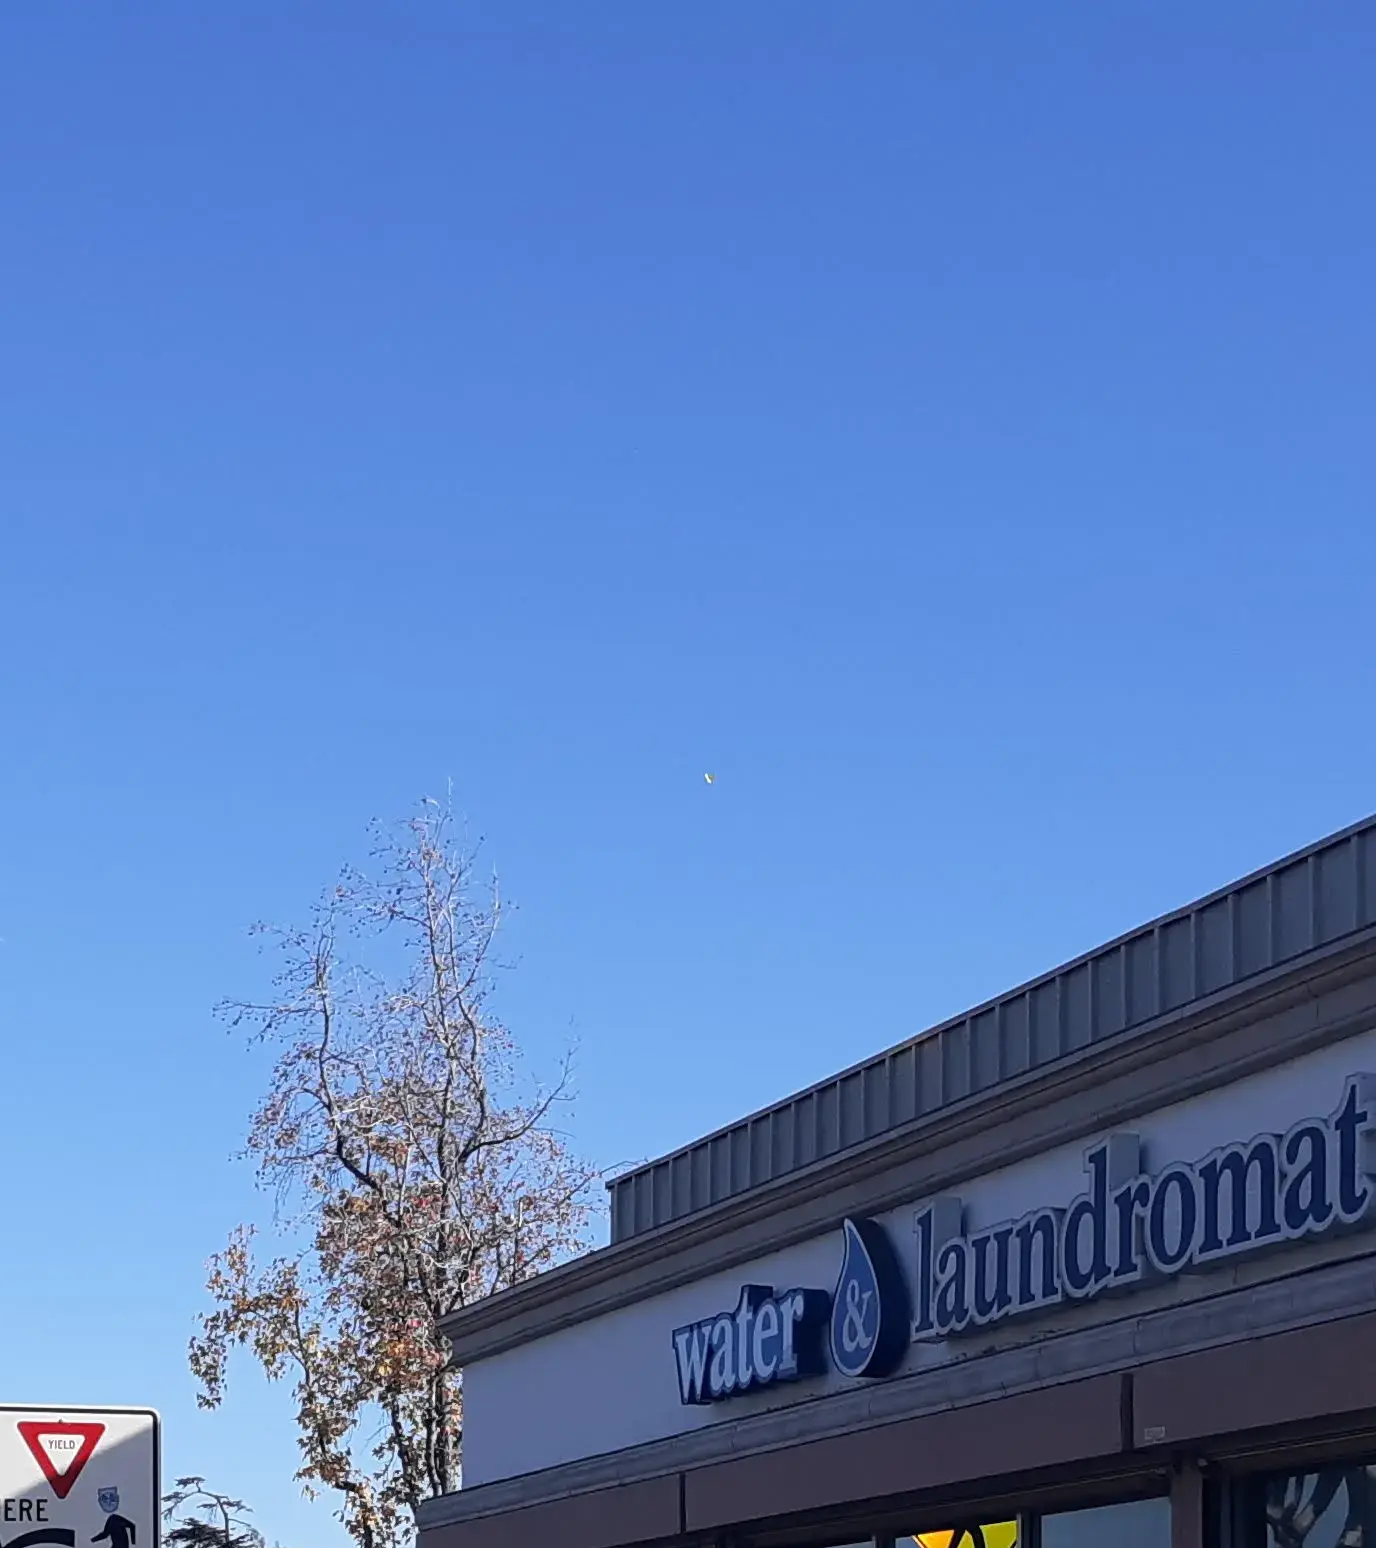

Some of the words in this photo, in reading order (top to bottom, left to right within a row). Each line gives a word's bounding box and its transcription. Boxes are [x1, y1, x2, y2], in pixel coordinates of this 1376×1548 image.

[674, 1290, 804, 1404] water
[914, 1083, 1369, 1338] laundromat
[48, 1439, 76, 1450] YIELD
